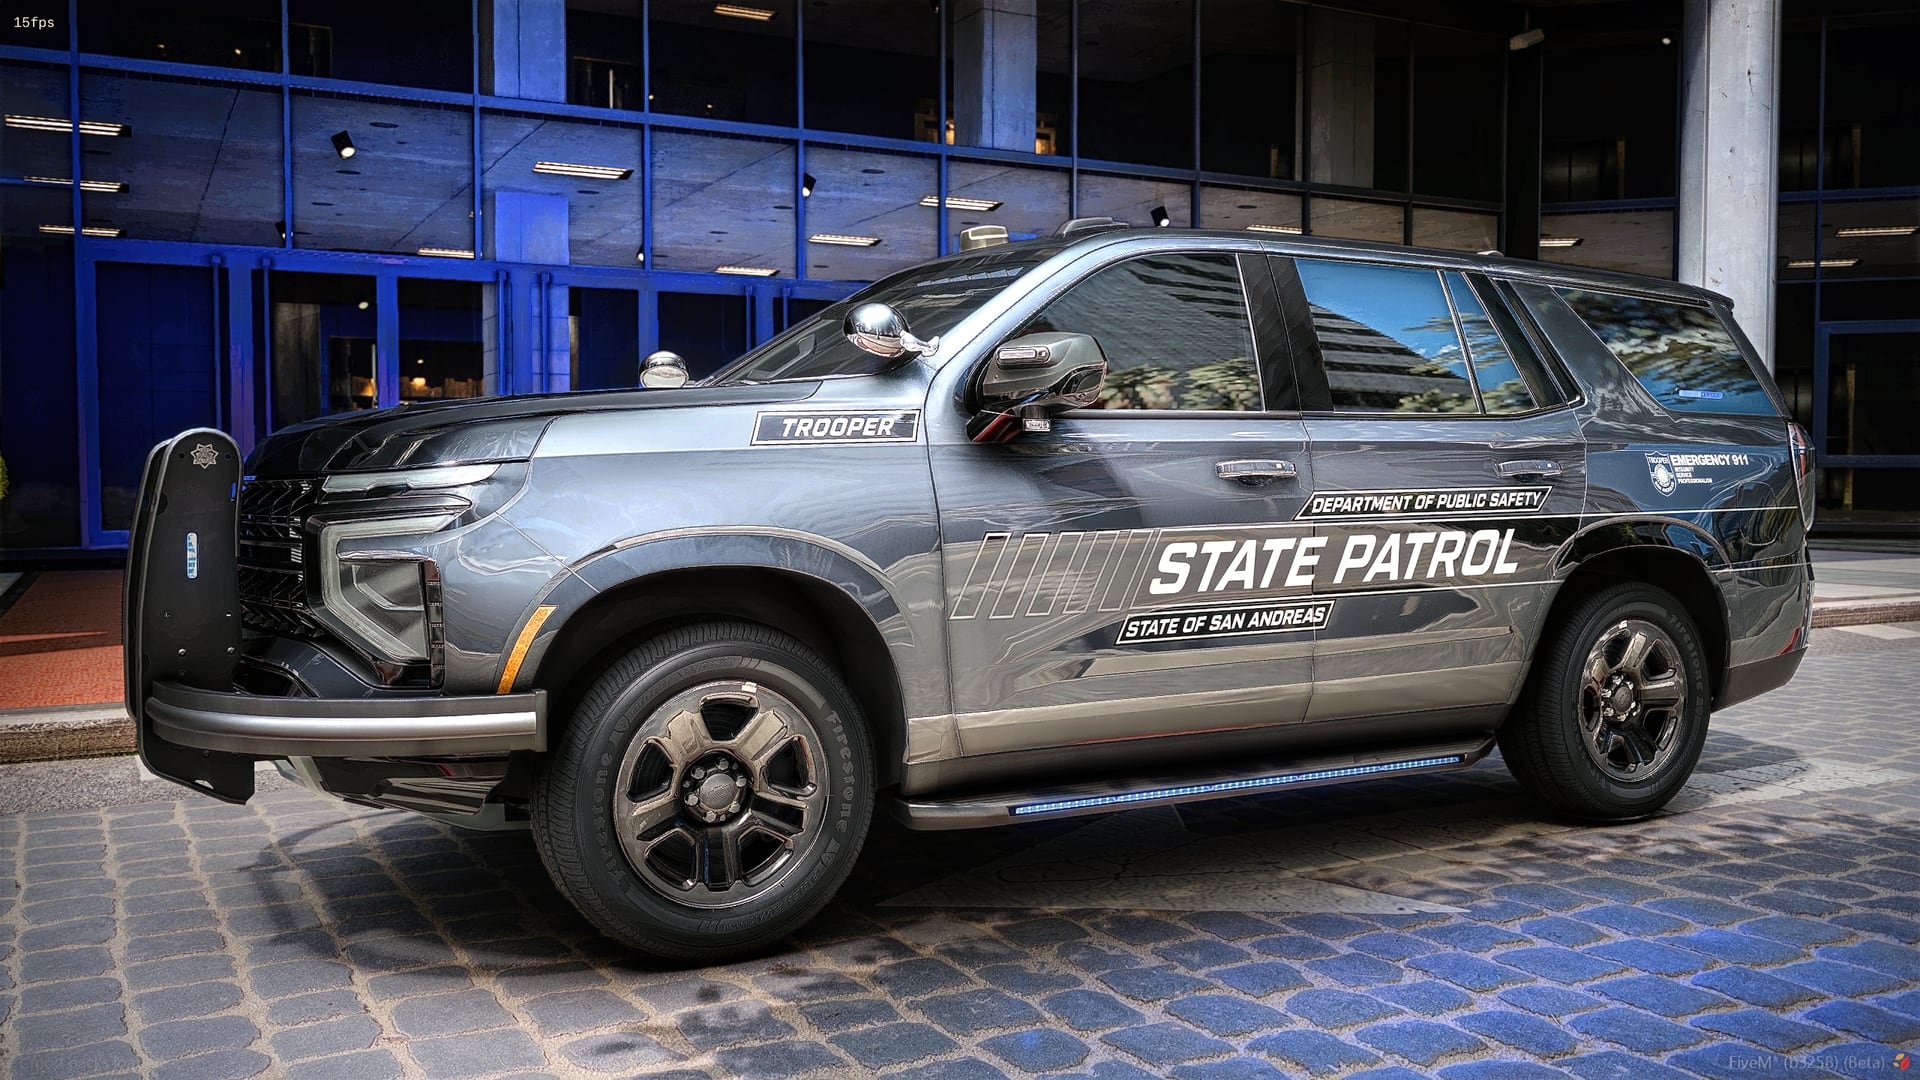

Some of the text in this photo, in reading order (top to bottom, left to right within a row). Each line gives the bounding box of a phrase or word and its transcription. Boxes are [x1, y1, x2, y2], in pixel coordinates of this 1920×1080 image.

[782, 417, 895, 437] TROOPER
[1670, 454, 1749, 466] EMERGENCY 911
[1312, 491, 1542, 513] DEPARTMENT OF PUBLIC SAFETY
[1149, 528, 1521, 595] STATE PATROL
[1126, 606, 1326, 638] STATE OF SAN ANDREAS
[825, 710, 855, 833] Firestone
